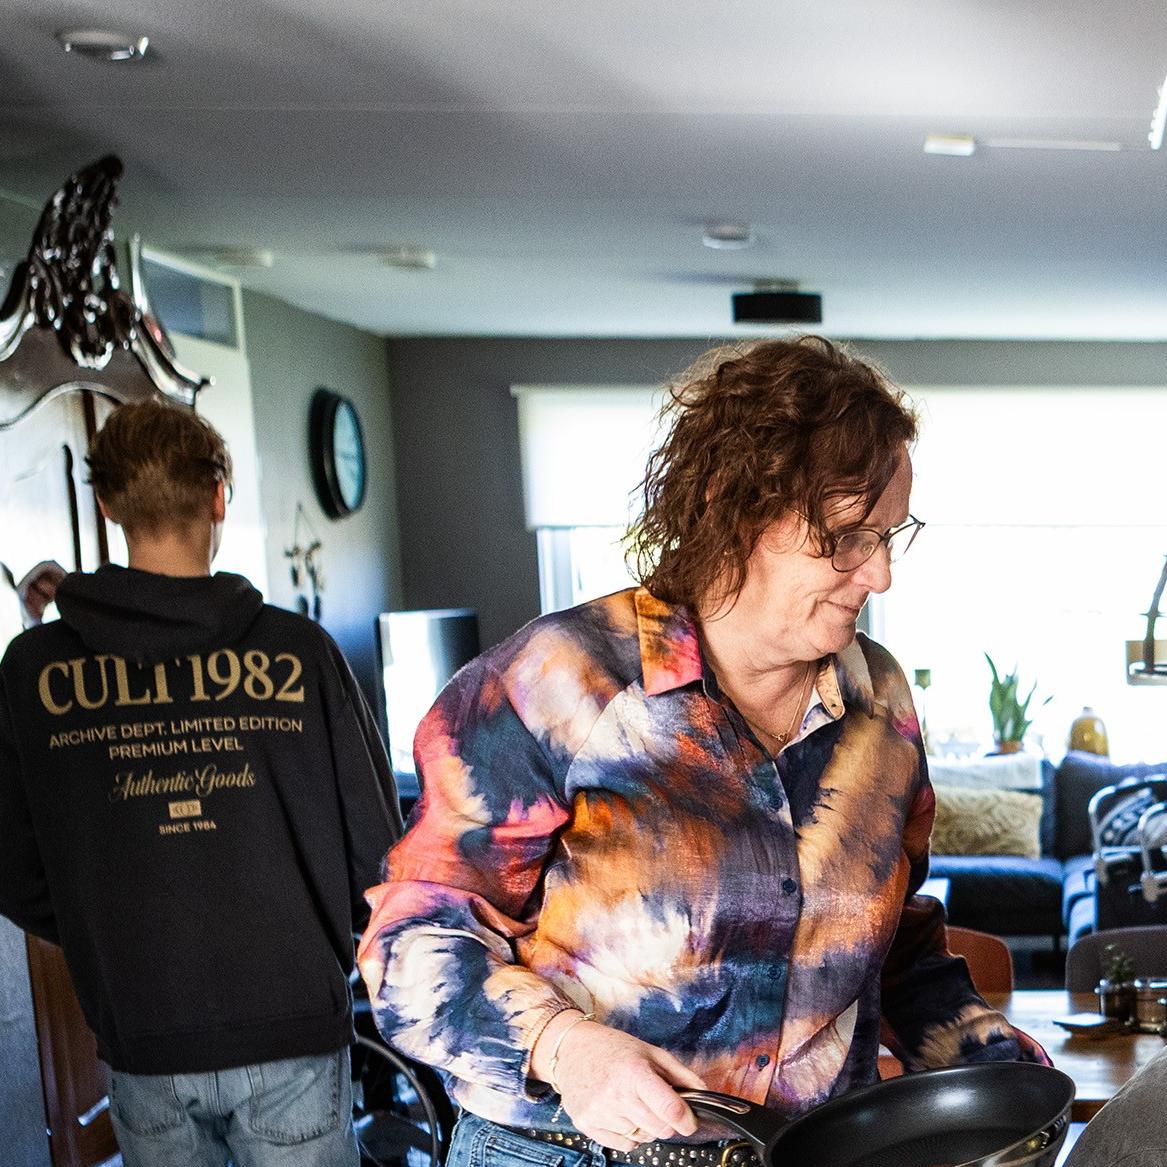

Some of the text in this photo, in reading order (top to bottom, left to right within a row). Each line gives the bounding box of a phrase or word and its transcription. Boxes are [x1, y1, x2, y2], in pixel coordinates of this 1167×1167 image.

[38, 648, 305, 716] CULT 1982
[49, 716, 303, 750] ARCHIVE DEPT. LIMITED EDITION
[108, 736, 244, 760] PREMIUM LEVEL
[112, 762, 257, 801] Authentic Goods
[159, 822, 190, 835] SINCE
